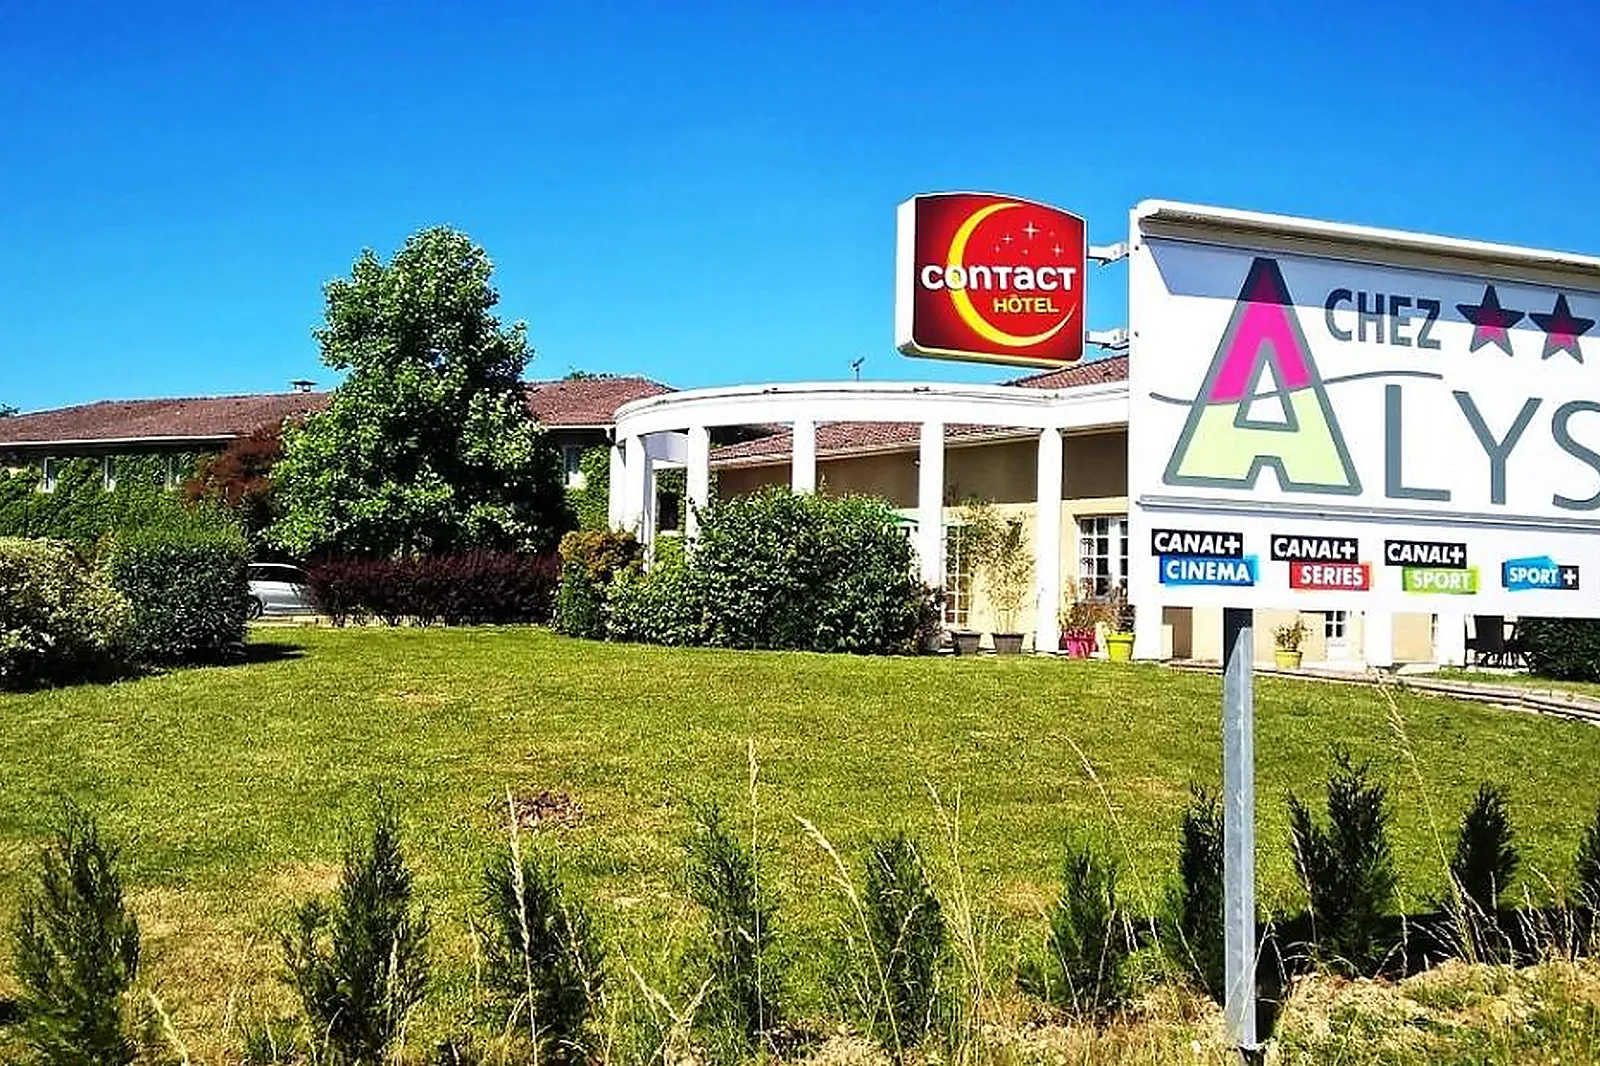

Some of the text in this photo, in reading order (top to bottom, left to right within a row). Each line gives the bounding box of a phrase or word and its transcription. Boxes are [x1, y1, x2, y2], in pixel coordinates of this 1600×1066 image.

[993, 295, 1060, 314] HÔTEL
[1324, 288, 1442, 350] CHEZ
[1154, 532, 1241, 555] CANAL+
[1273, 538, 1356, 560] CANAL+
[1387, 543, 1464, 565] CANAL+
[1166, 560, 1251, 582] CINEMA
[1301, 565, 1364, 586] SERIES
[1412, 571, 1472, 590] SPORT
